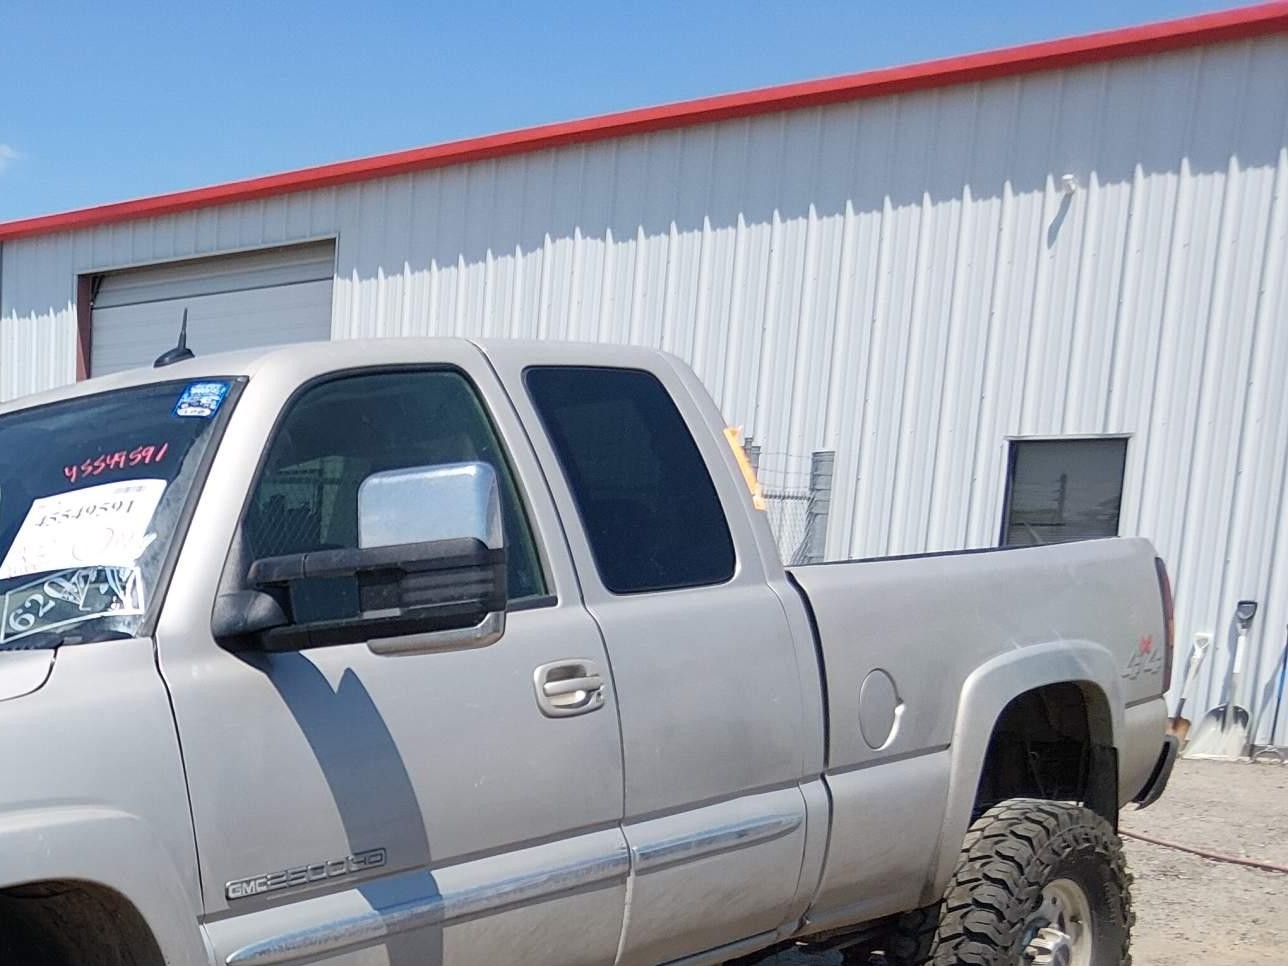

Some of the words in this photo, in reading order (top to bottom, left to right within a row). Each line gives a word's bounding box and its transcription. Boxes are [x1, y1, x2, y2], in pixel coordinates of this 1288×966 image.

[63, 442, 169, 483] 45549591
[34, 499, 135, 528] 45549591
[227, 876, 268, 899] GMC
